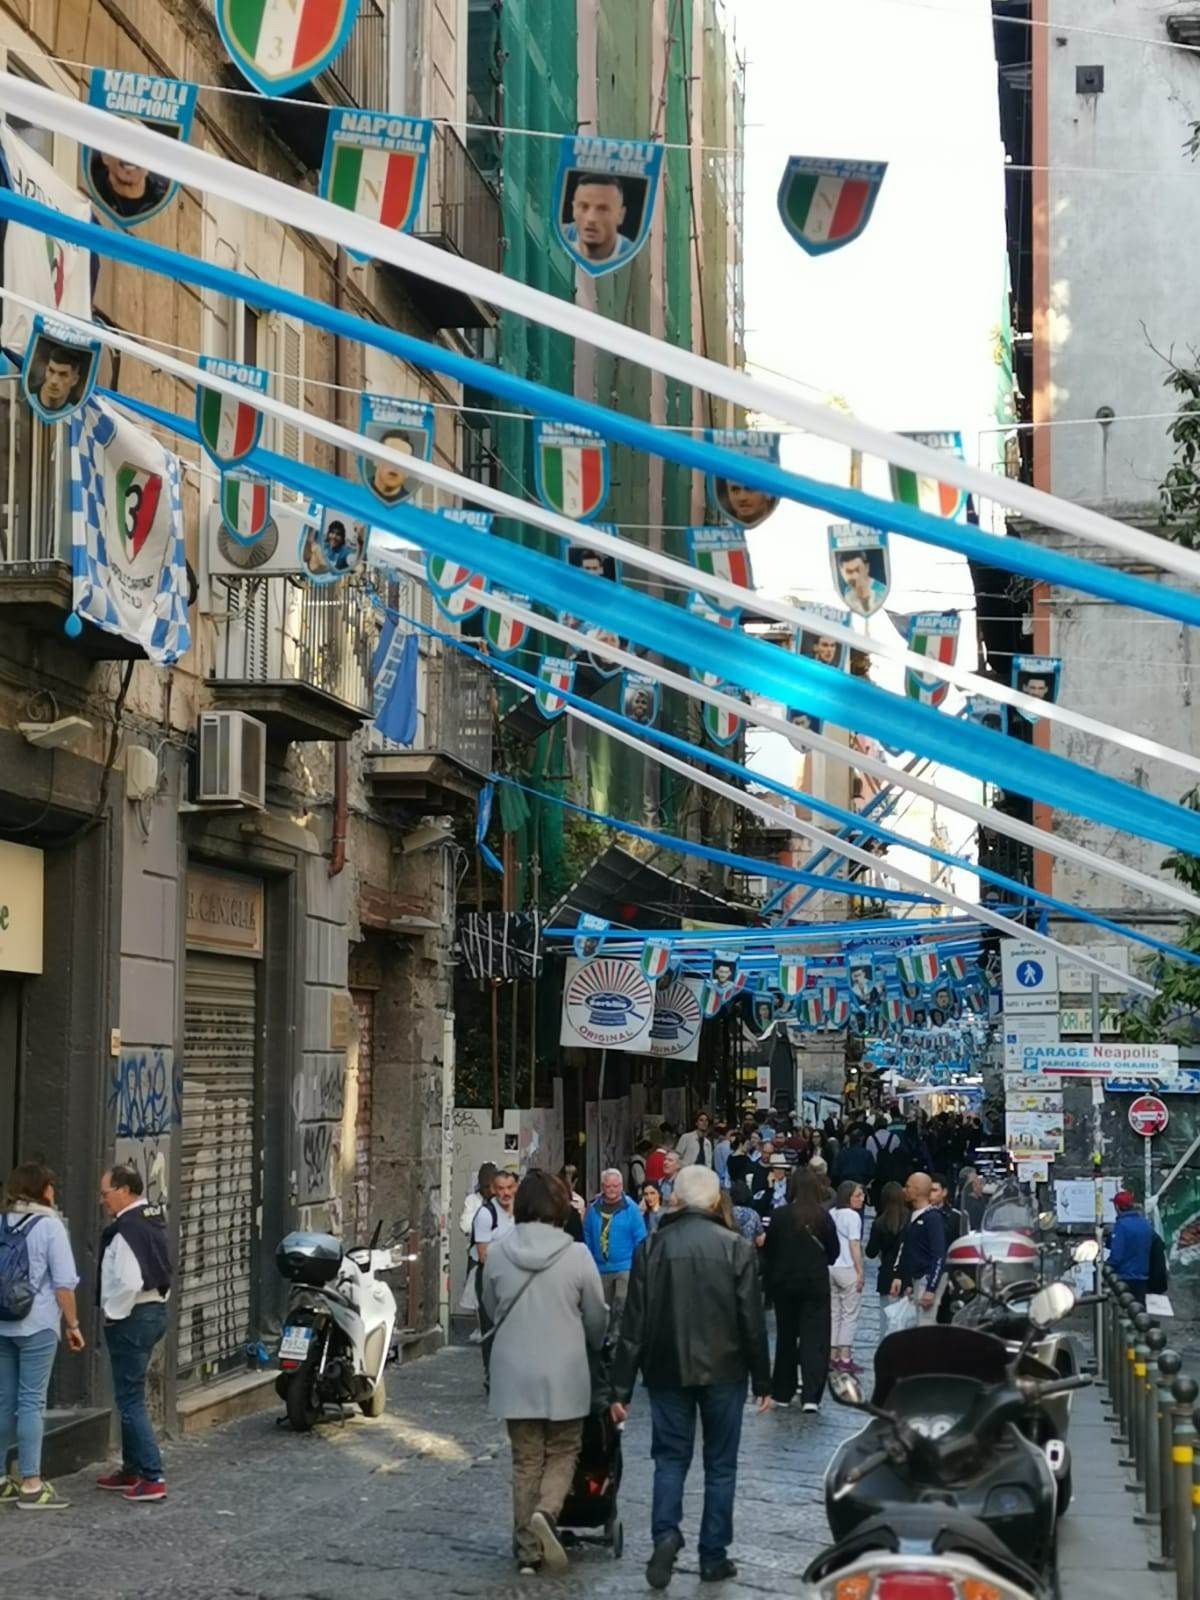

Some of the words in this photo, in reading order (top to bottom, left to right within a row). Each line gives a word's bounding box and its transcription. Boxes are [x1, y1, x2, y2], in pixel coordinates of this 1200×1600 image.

[268, 36, 283, 60] 3
[103, 70, 189, 106] NAPOLI
[105, 91, 180, 122] CAMPIONE
[341, 111, 424, 141] NAPOLI
[572, 138, 655, 163] NAPOLI
[206, 359, 263, 388] NAPOLI
[124, 484, 143, 540] 3
[579, 1024, 634, 1042] ORIGINAL
[1023, 1046, 1089, 1058] GARAGE
[1093, 1046, 1160, 1060] Neapolis
[1040, 1060, 1112, 1069] PARCHEGGIO
[1113, 1061, 1160, 1070] ORARIO
